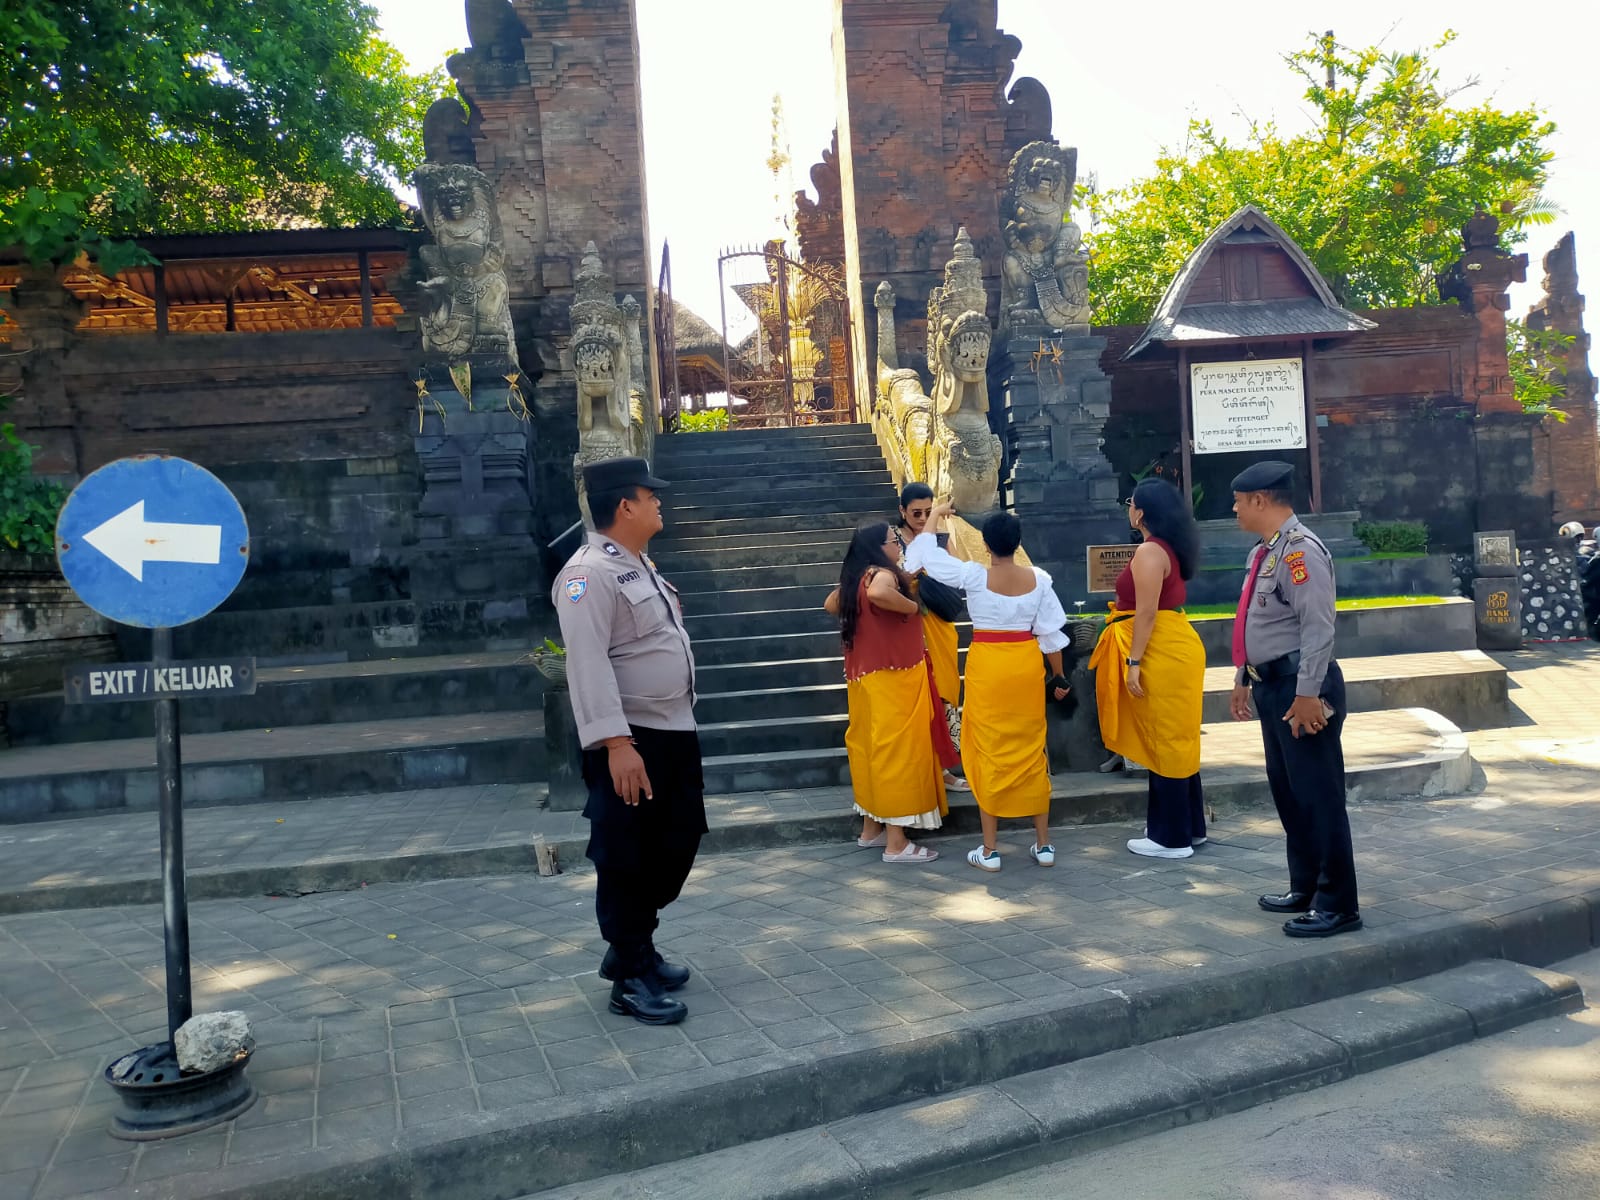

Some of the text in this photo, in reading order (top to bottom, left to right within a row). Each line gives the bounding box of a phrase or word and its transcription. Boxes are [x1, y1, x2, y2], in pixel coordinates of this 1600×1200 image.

[1218, 387, 1247, 395] MASCETI
[1228, 414, 1269, 423] PETITENGET
[1099, 551, 1135, 560] ATTENTIO
[617, 570, 641, 585] GUSTI
[89, 665, 234, 696] EXIT / KELUAR
